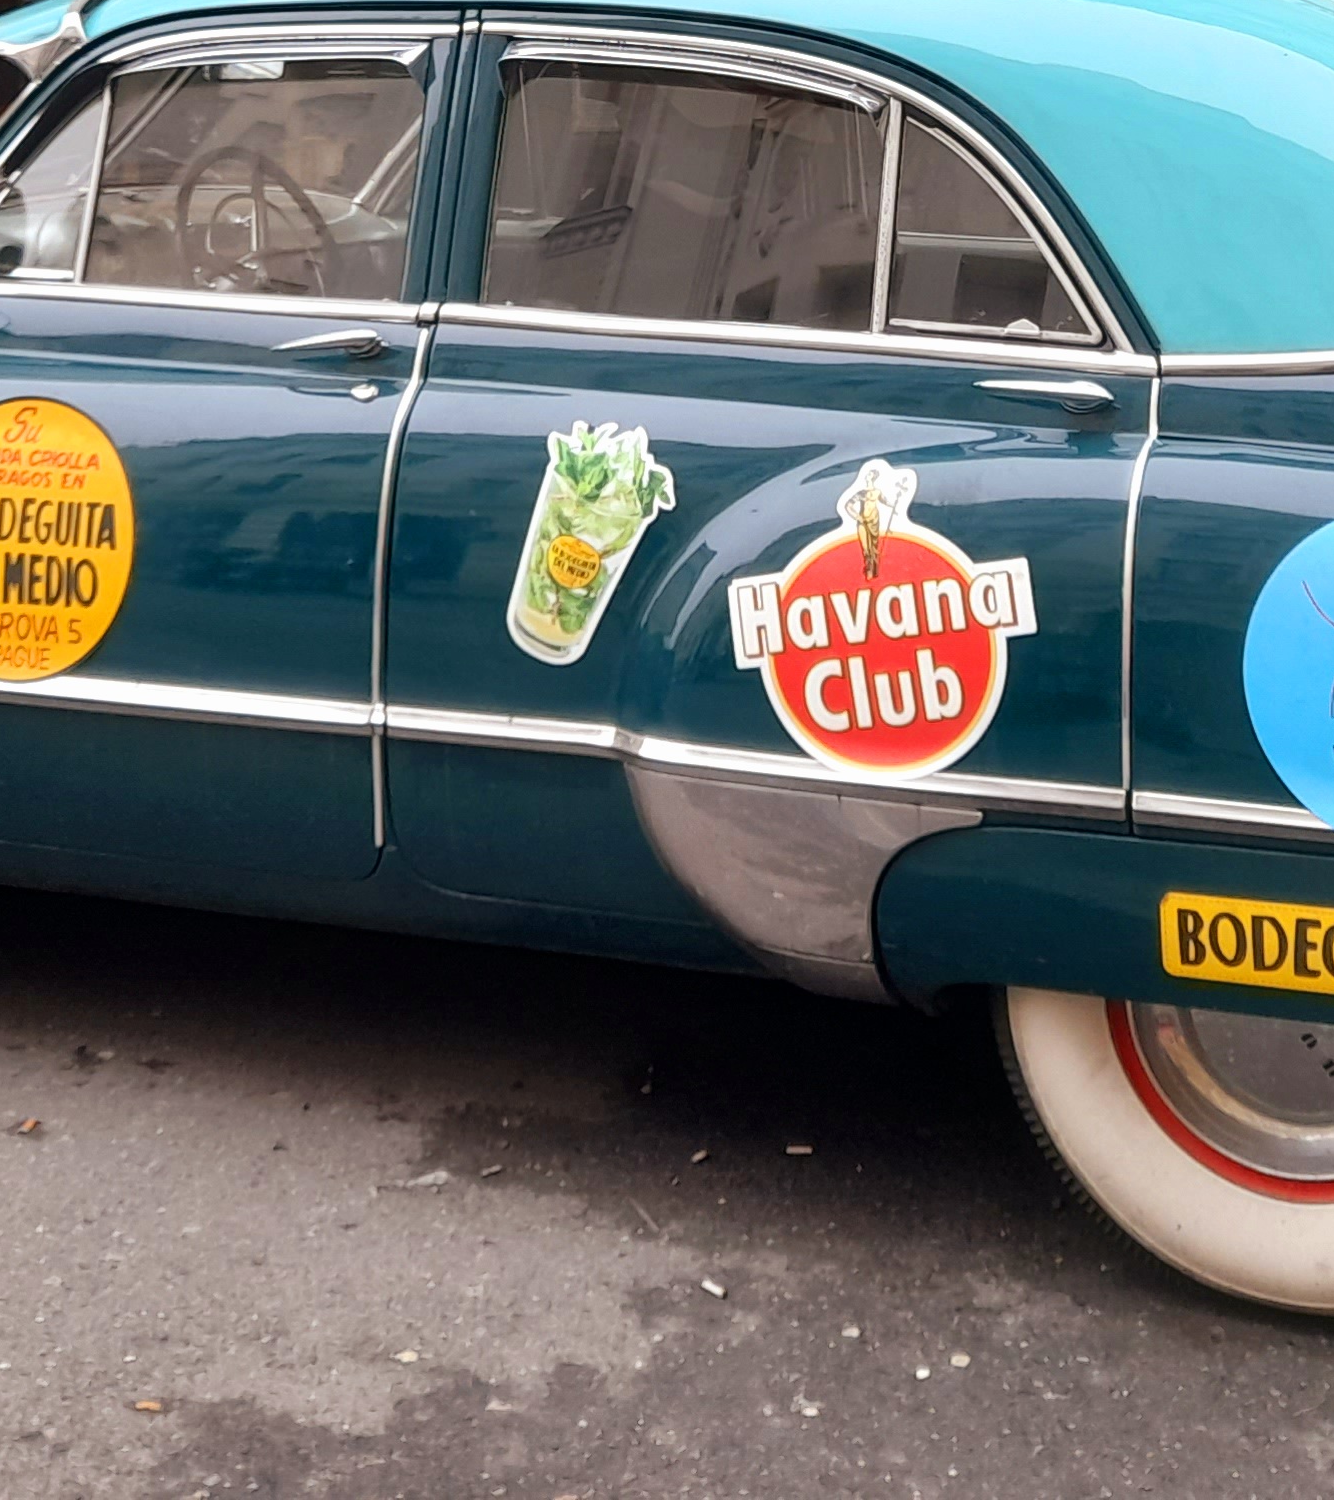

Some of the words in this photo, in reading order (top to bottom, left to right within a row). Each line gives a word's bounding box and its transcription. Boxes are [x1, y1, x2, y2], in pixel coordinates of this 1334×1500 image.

[3, 406, 44, 444] Su
[28, 449, 101, 471] CRIOLLA
[60, 472, 87, 490] EN
[2, 551, 99, 608] MEDIO
[67, 618, 83, 645] 5
[735, 570, 1019, 659] Havana
[803, 647, 965, 733] Club
